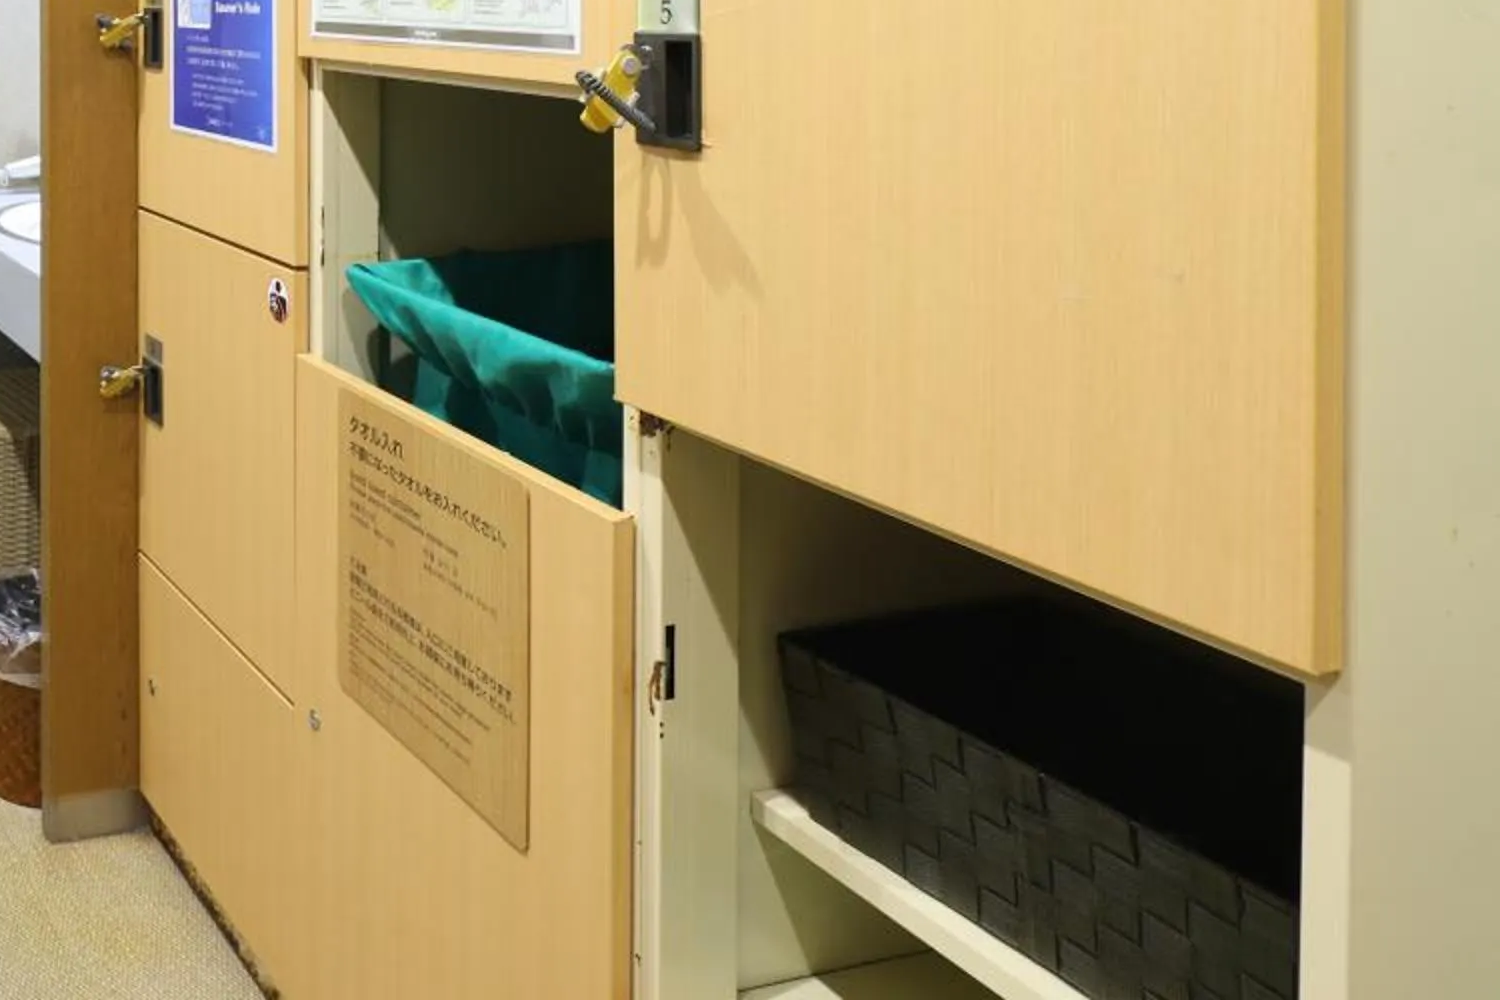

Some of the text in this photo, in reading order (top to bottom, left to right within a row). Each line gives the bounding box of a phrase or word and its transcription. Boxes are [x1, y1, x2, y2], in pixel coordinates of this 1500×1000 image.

[660, 0, 673, 25] 5
[349, 416, 404, 459] タオル入れ
